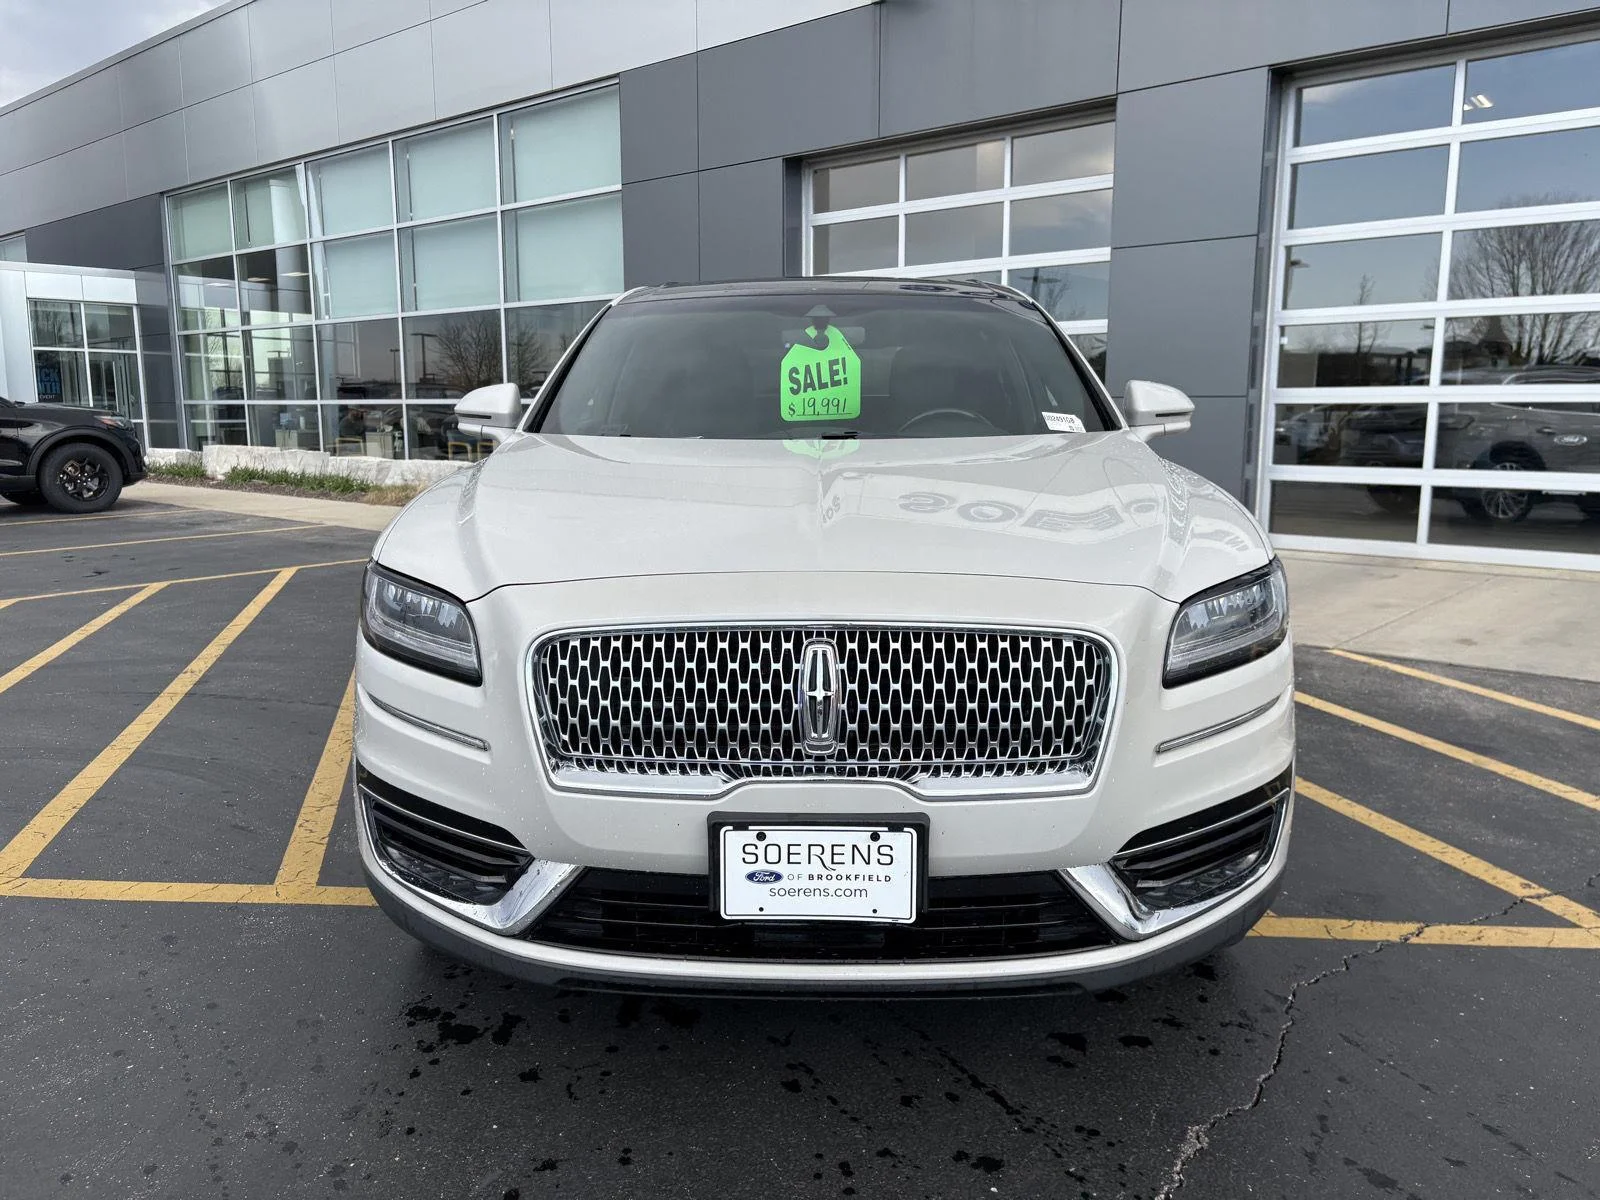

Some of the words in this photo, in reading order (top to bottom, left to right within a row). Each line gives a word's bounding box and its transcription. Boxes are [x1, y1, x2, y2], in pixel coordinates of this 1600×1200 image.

[788, 357, 848, 395] SALE!
[742, 843, 894, 871] SOERENS
[787, 873, 803, 881] OF
[808, 873, 892, 883] BROOKFIELD
[769, 887, 868, 898] soerens.com
